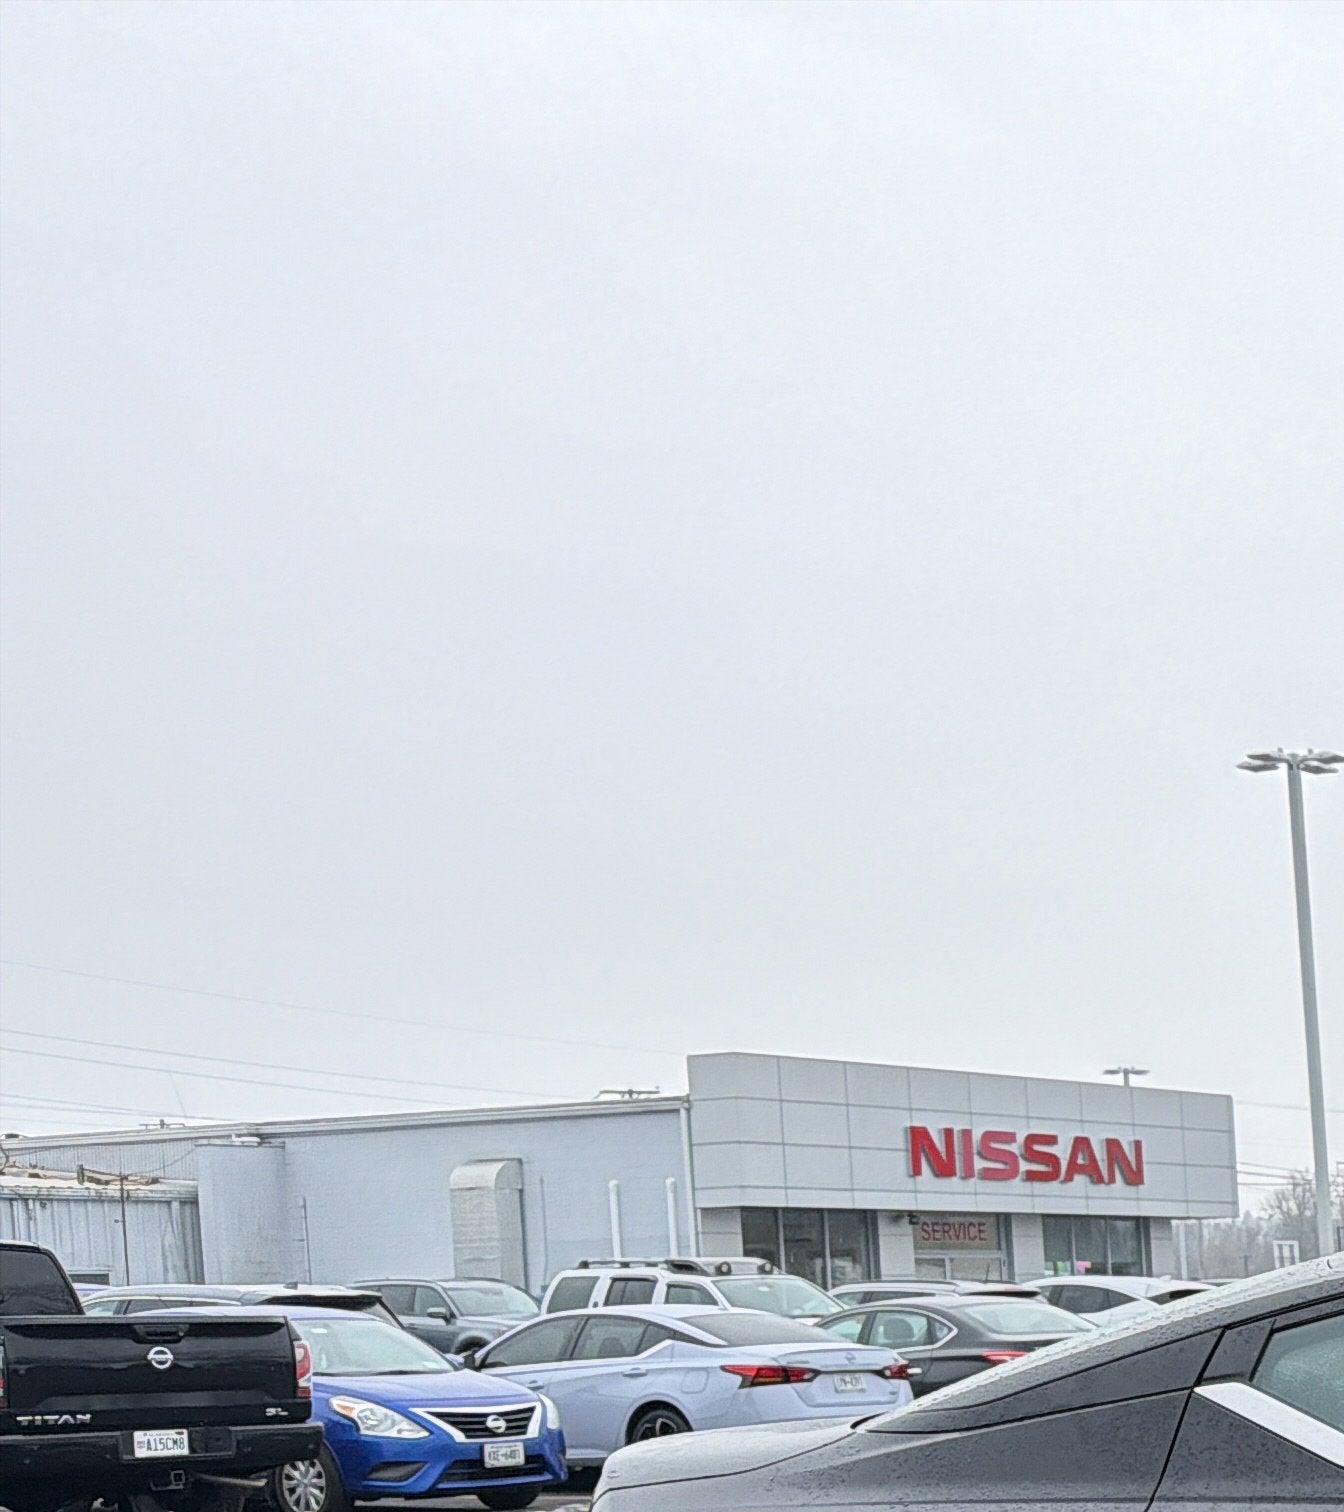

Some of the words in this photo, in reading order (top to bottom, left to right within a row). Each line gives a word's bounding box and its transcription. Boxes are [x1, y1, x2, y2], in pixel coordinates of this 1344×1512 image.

[908, 1125, 1145, 1186] NISSAN
[921, 1222, 988, 1242] SERVICE
[16, 1413, 92, 1425] TITAN
[146, 1436, 186, 1451] A15CM8
